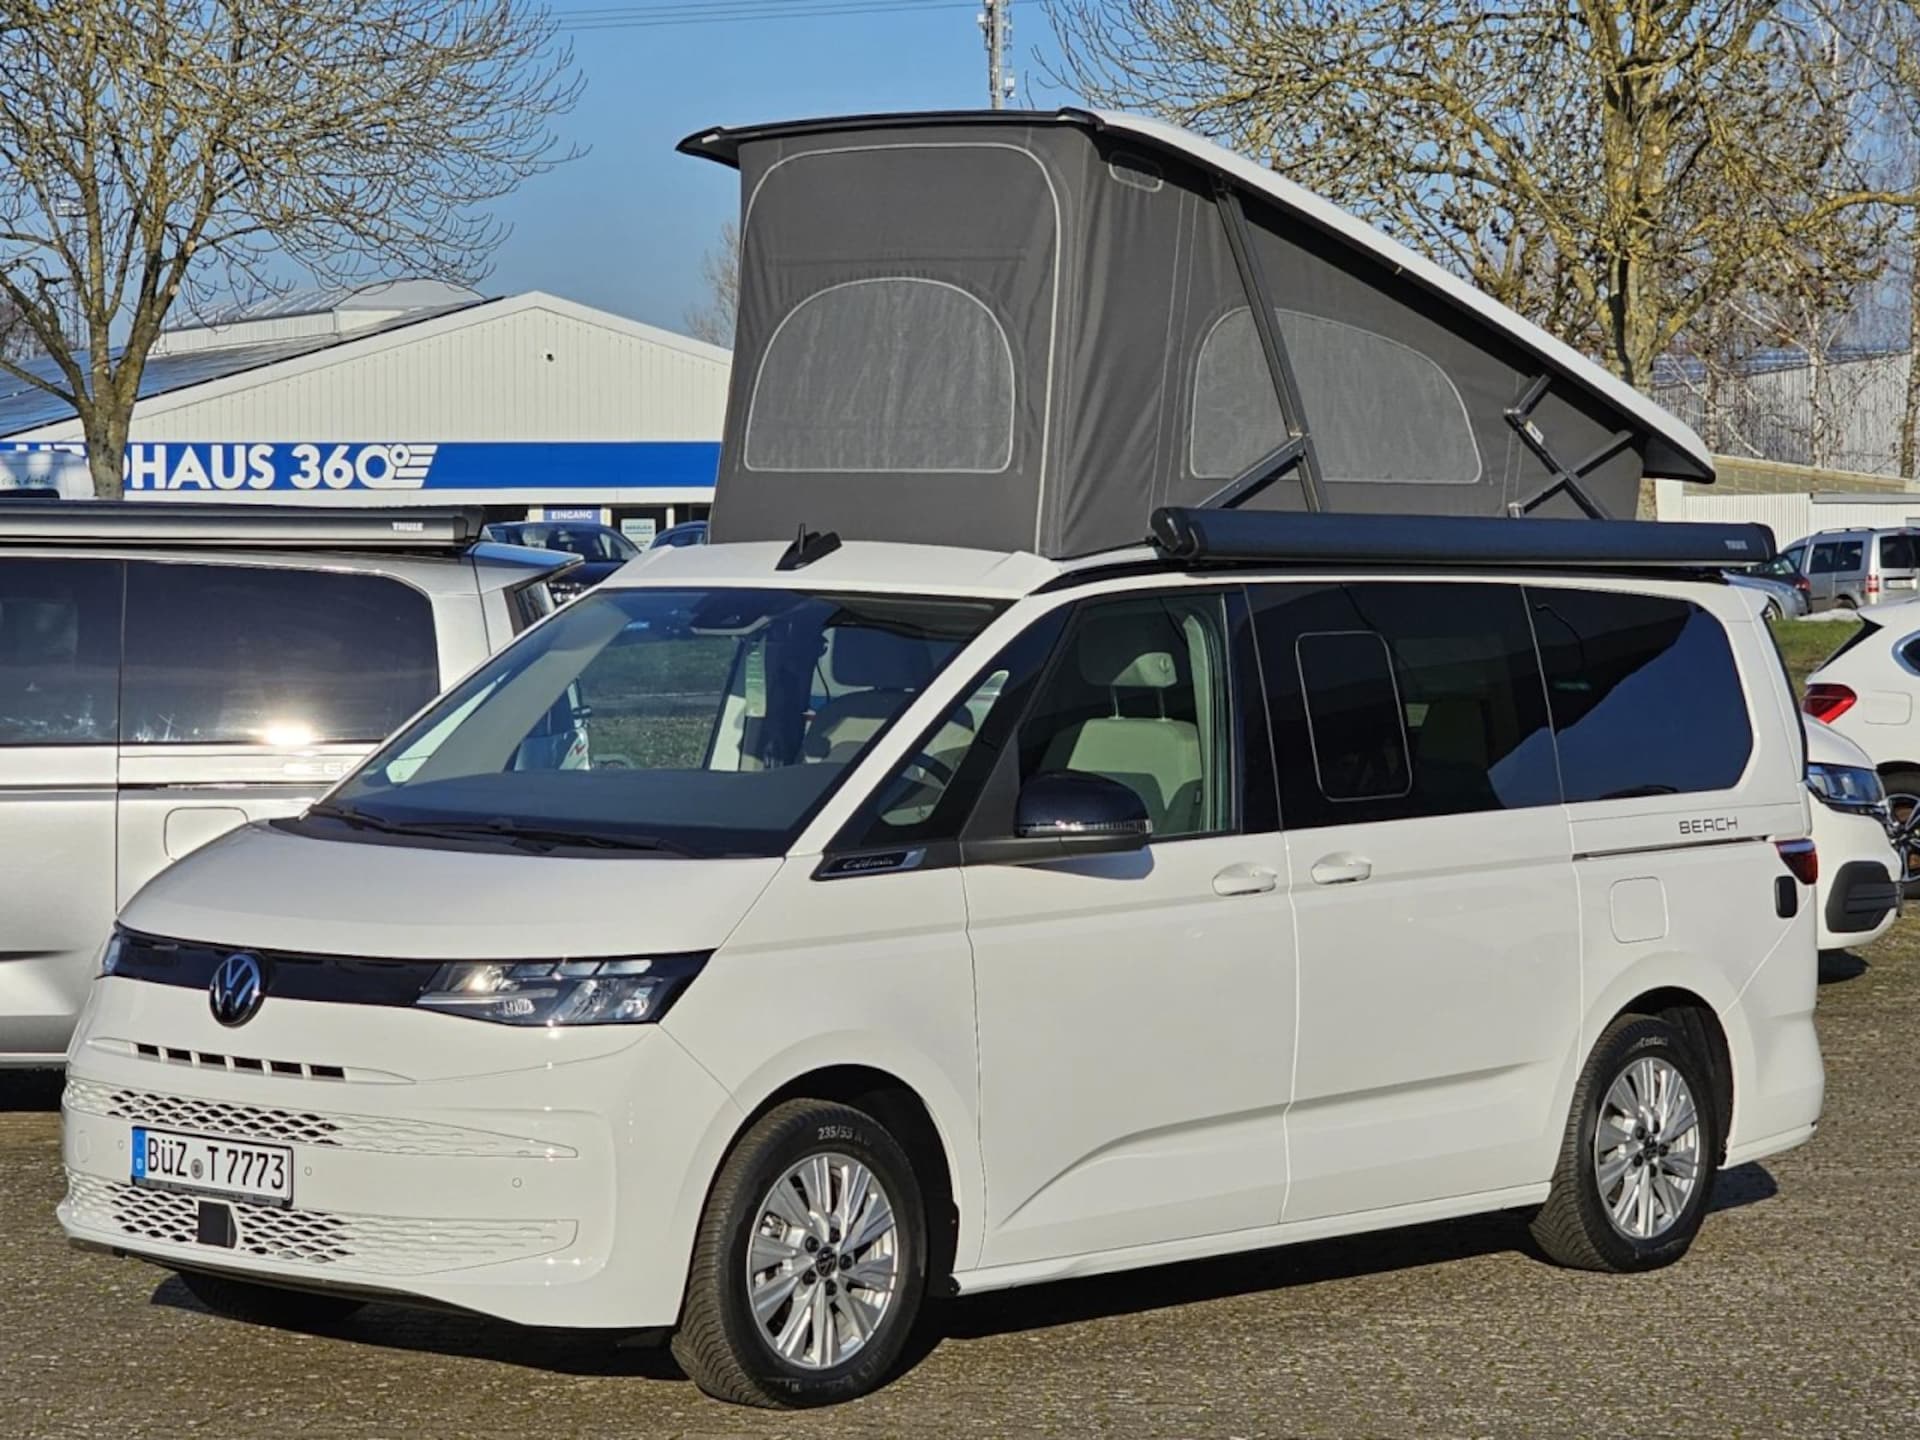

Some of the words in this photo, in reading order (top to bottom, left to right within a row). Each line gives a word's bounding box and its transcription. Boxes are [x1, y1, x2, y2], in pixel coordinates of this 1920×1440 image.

[551, 511, 593, 520] EINGANG
[392, 521, 424, 531] THULE
[1679, 816, 1738, 834] BEACH
[207, 1145, 219, 1182] T
[226, 1149, 285, 1190] 7773
